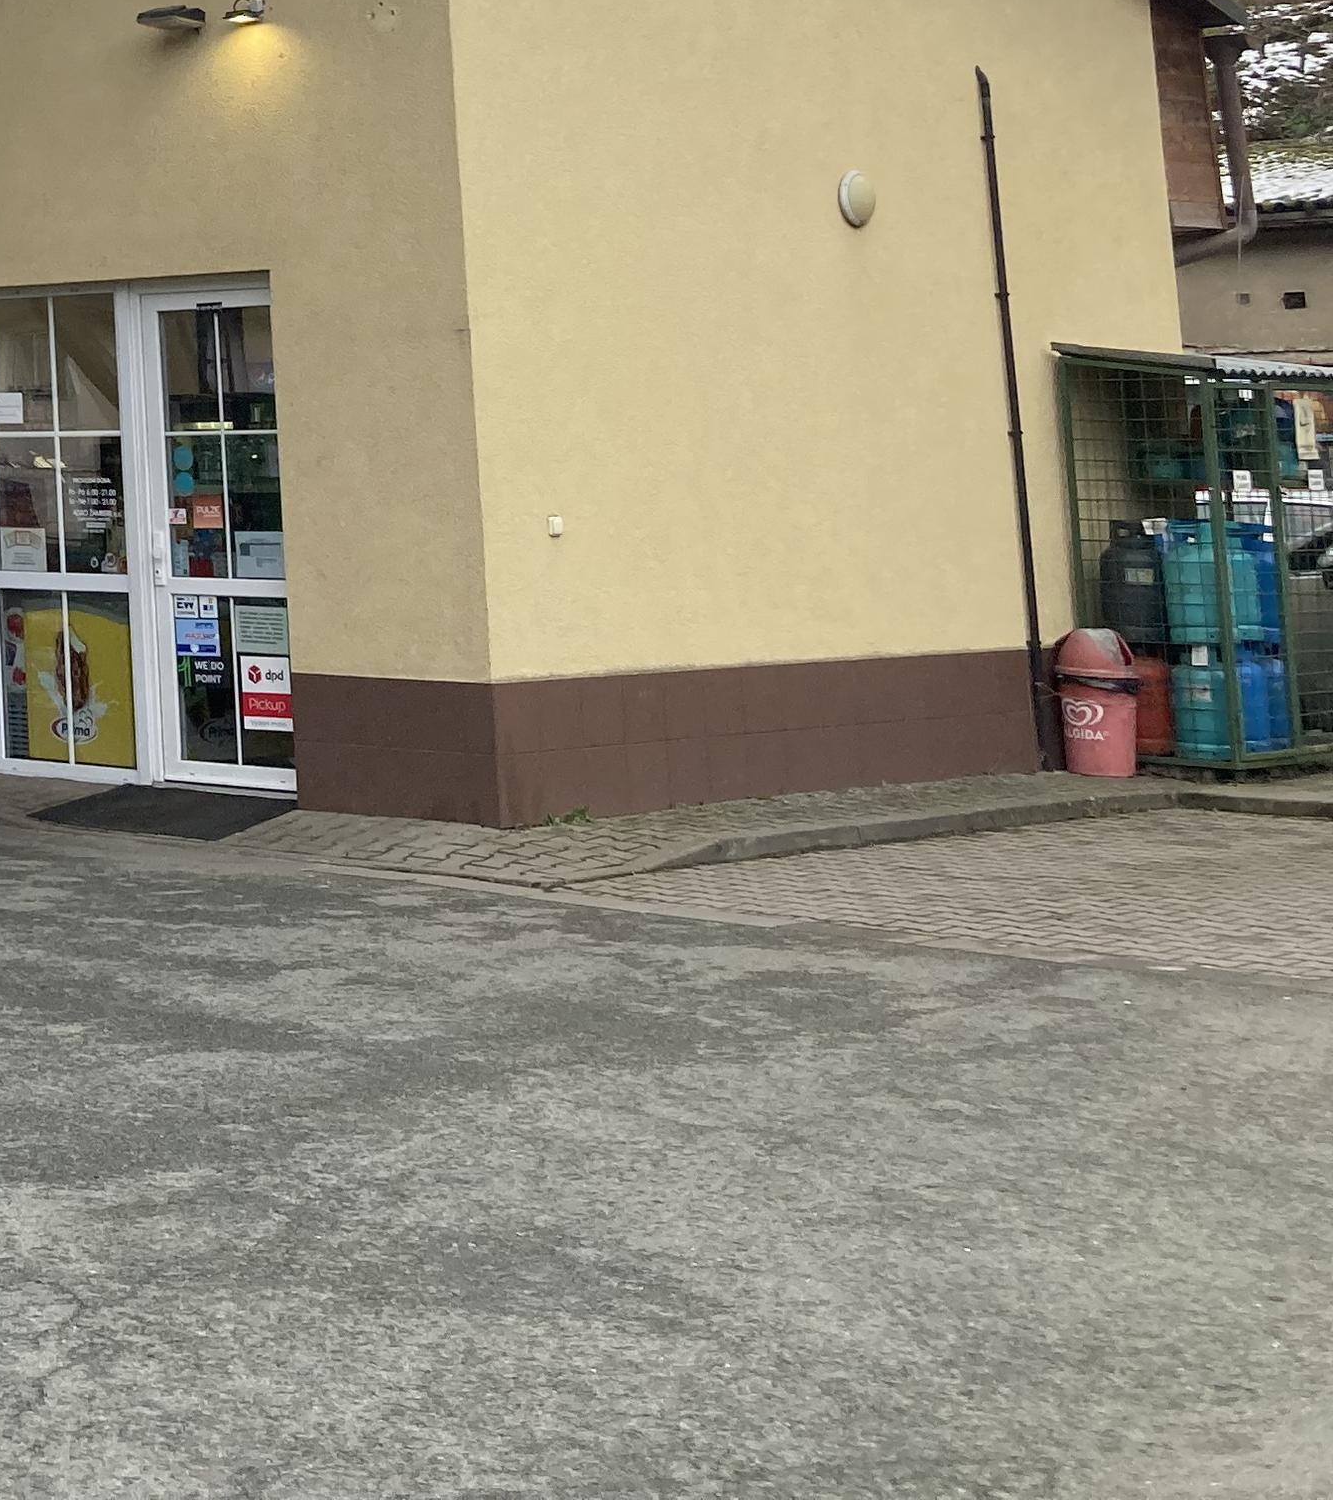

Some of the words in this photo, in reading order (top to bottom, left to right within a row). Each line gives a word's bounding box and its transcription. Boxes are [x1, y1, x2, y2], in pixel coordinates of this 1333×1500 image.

[194, 674, 223, 684] POINT
[265, 669, 284, 684] dpd
[248, 697, 286, 714] Pickup
[1065, 727, 1105, 741] LGIDA
